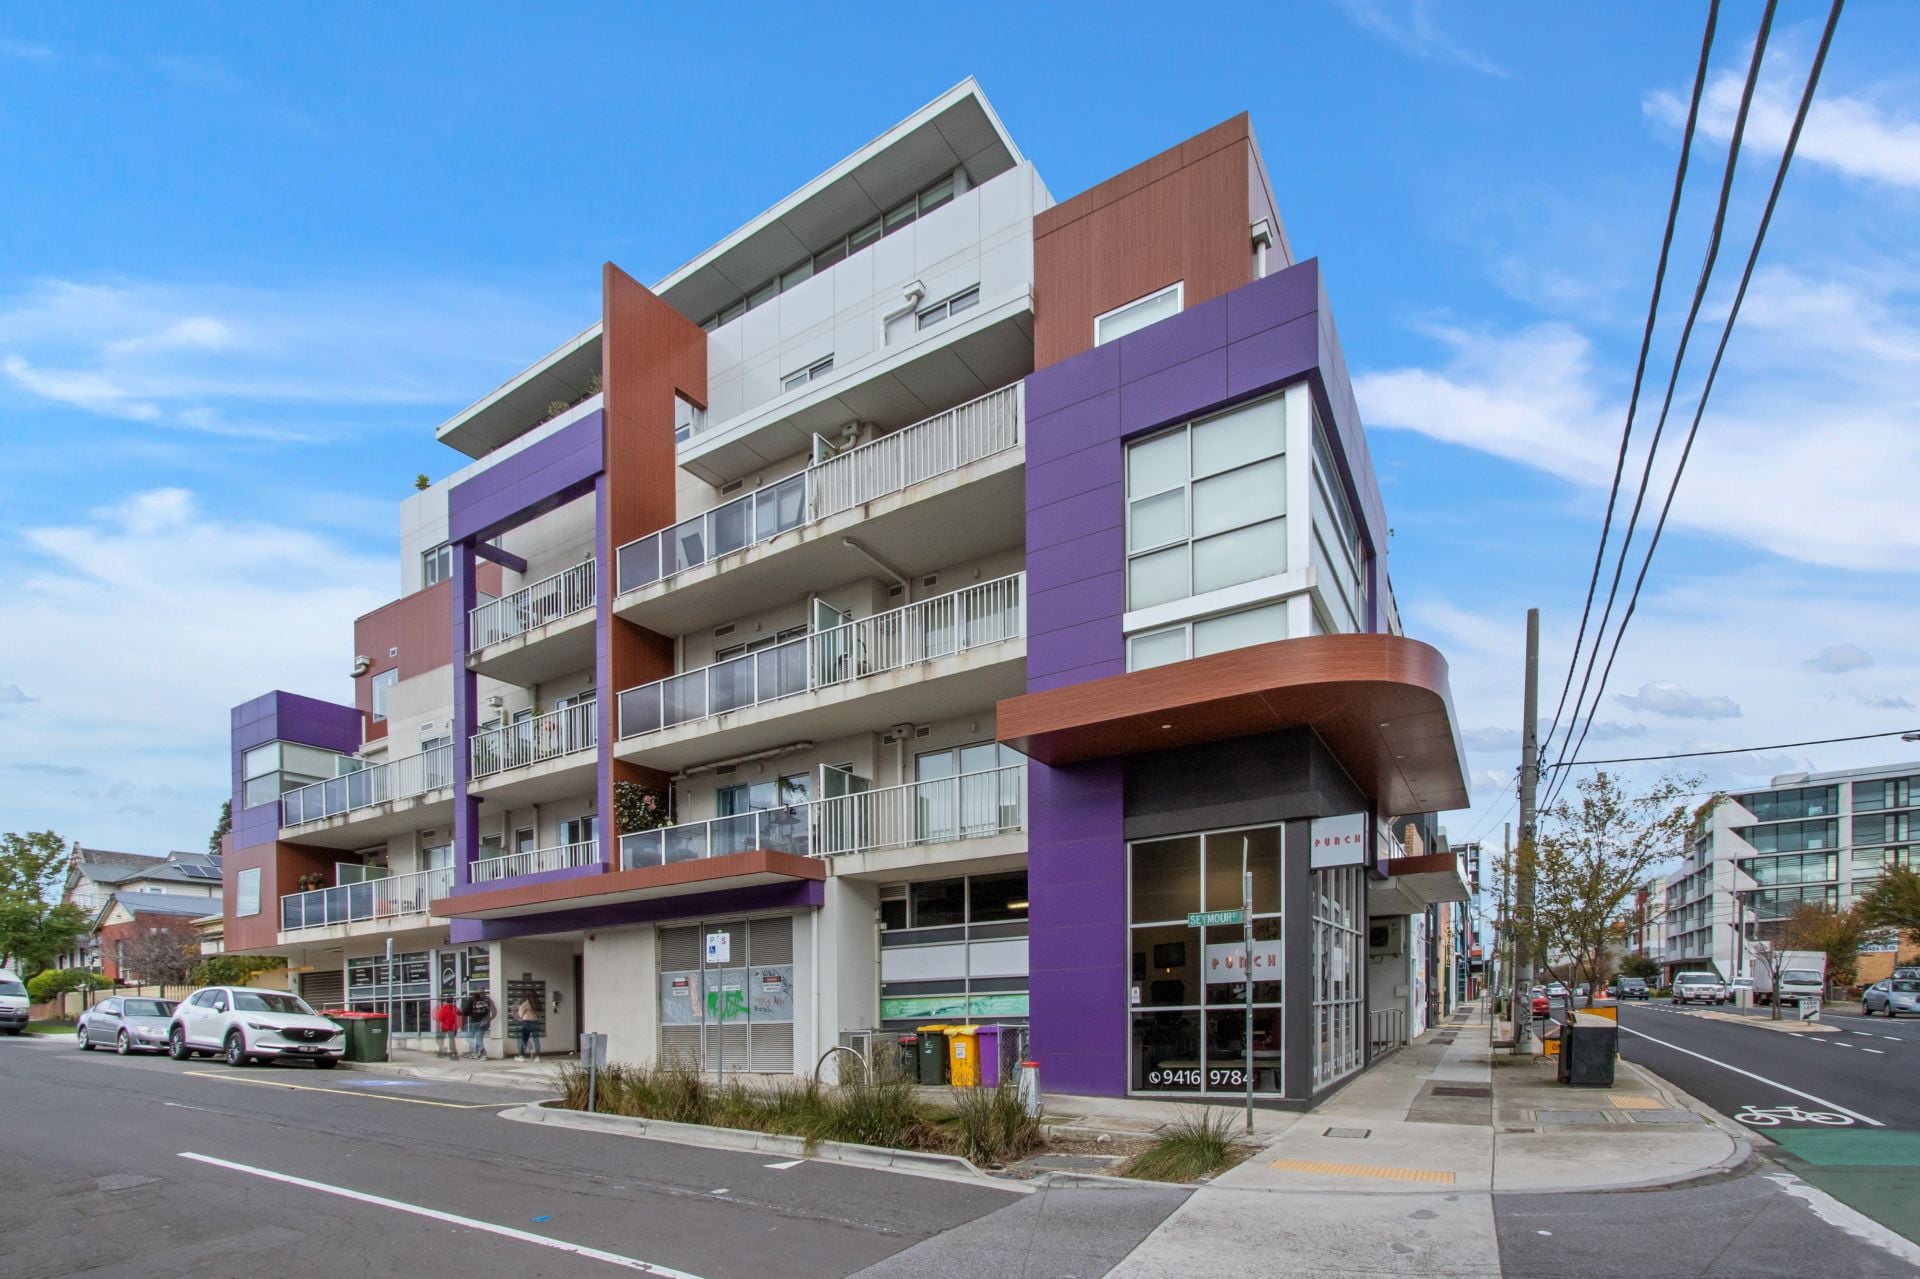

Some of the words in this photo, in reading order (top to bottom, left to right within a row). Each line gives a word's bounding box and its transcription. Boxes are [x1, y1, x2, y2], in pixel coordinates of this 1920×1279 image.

[1314, 834, 1361, 847] PUNCH
[1190, 912, 1232, 926] SEYMOUR
[1211, 954, 1276, 970] PUNCH
[1163, 1070, 1200, 1085] 9416
